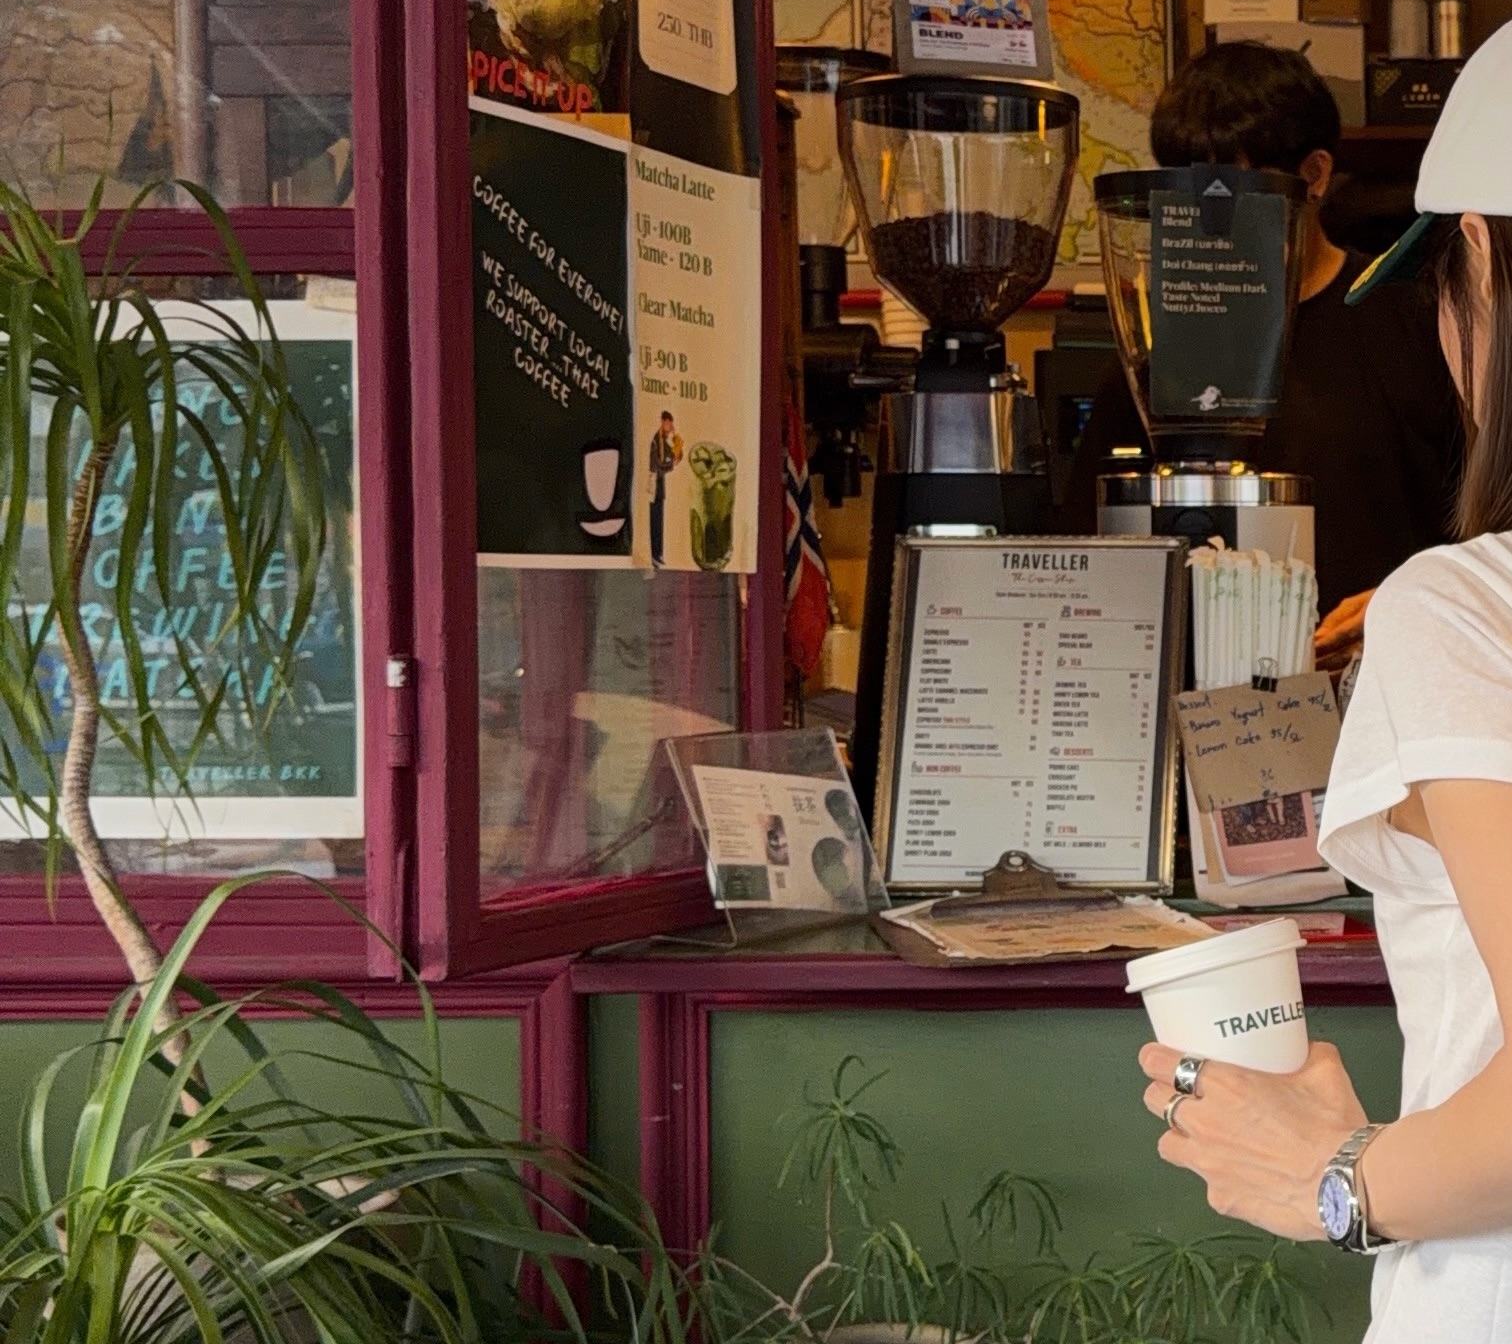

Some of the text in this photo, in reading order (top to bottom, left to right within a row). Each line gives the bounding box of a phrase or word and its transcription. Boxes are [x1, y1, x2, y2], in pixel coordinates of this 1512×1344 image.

[688, 20, 714, 50] THB
[918, 29, 965, 40] BLEND
[474, 50, 527, 99] PICE
[557, 80, 593, 122] UP
[635, 159, 716, 202] Matcha Latte
[473, 175, 529, 244] COFFEE
[529, 231, 556, 271] FOR
[636, 212, 651, 239] Uji
[1162, 216, 1193, 227] Blend
[637, 238, 713, 277] Yame 120 B
[1181, 260, 1214, 272] Chang
[1200, 282, 1242, 293] Medium
[1243, 283, 1268, 294] Dark
[482, 250, 612, 383] WE SUPPORT LOCAL
[486, 288, 549, 360] ROASTER
[638, 293, 715, 329] Clear Matcha
[515, 346, 572, 409] COFFEE
[679, 380, 698, 400] 110
[1002, 552, 1089, 572] TRAVELLER
